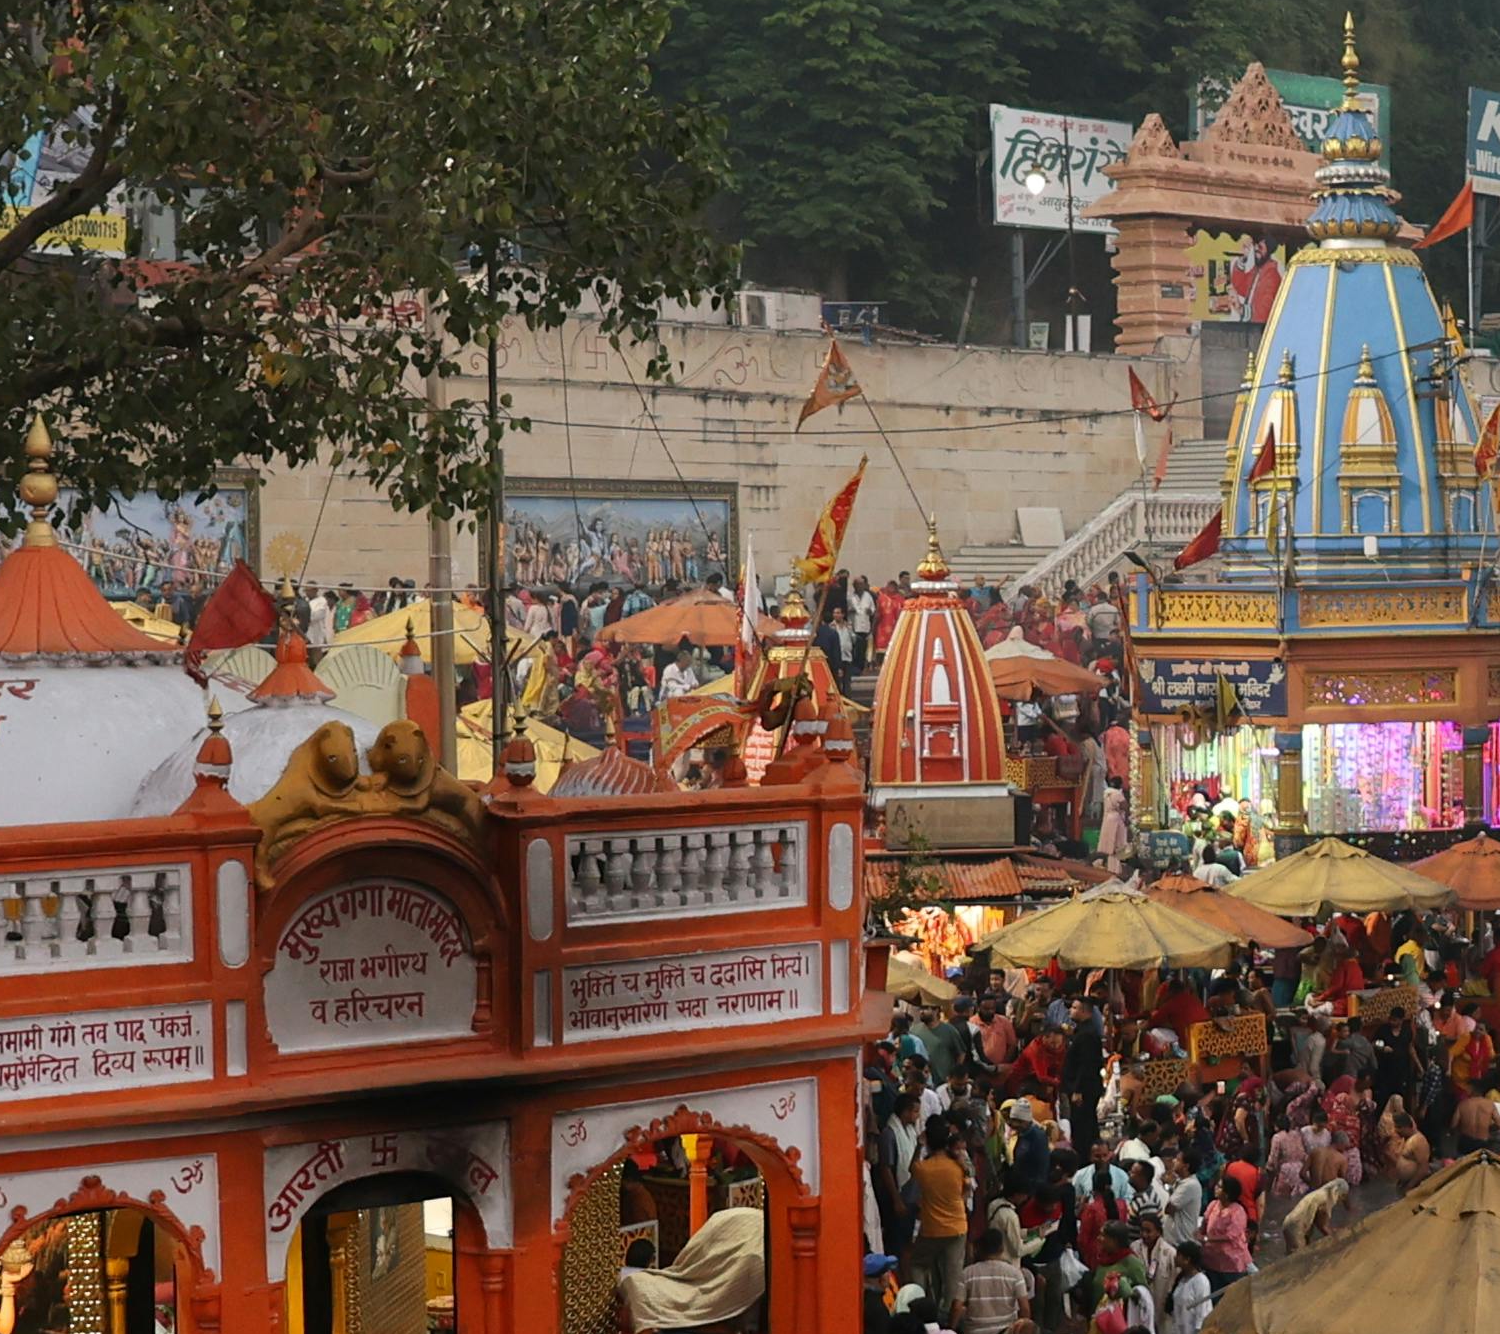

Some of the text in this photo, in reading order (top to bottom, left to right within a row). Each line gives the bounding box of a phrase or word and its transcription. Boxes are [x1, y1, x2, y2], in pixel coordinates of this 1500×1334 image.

[1151, 675, 1166, 696] श्री
[1238, 677, 1271, 698] मन्दिर
[279, 895, 340, 965] मुख्य
[320, 944, 429, 985] राजा भगीरथ
[621, 972, 641, 993] च
[690, 966, 706, 986] च
[709, 955, 767, 987] ददासि
[309, 988, 425, 1028] व हरिचरन
[676, 997, 709, 1020] सदा
[716, 989, 785, 1015] नराणाम
[48, 1020, 77, 1048] गंगे
[81, 1022, 109, 1046] तव
[114, 1019, 147, 1044] पाद
[92, 1048, 136, 1078] दिव्य
[143, 1045, 192, 1074] रूपम्
[268, 1140, 345, 1234] आरती
